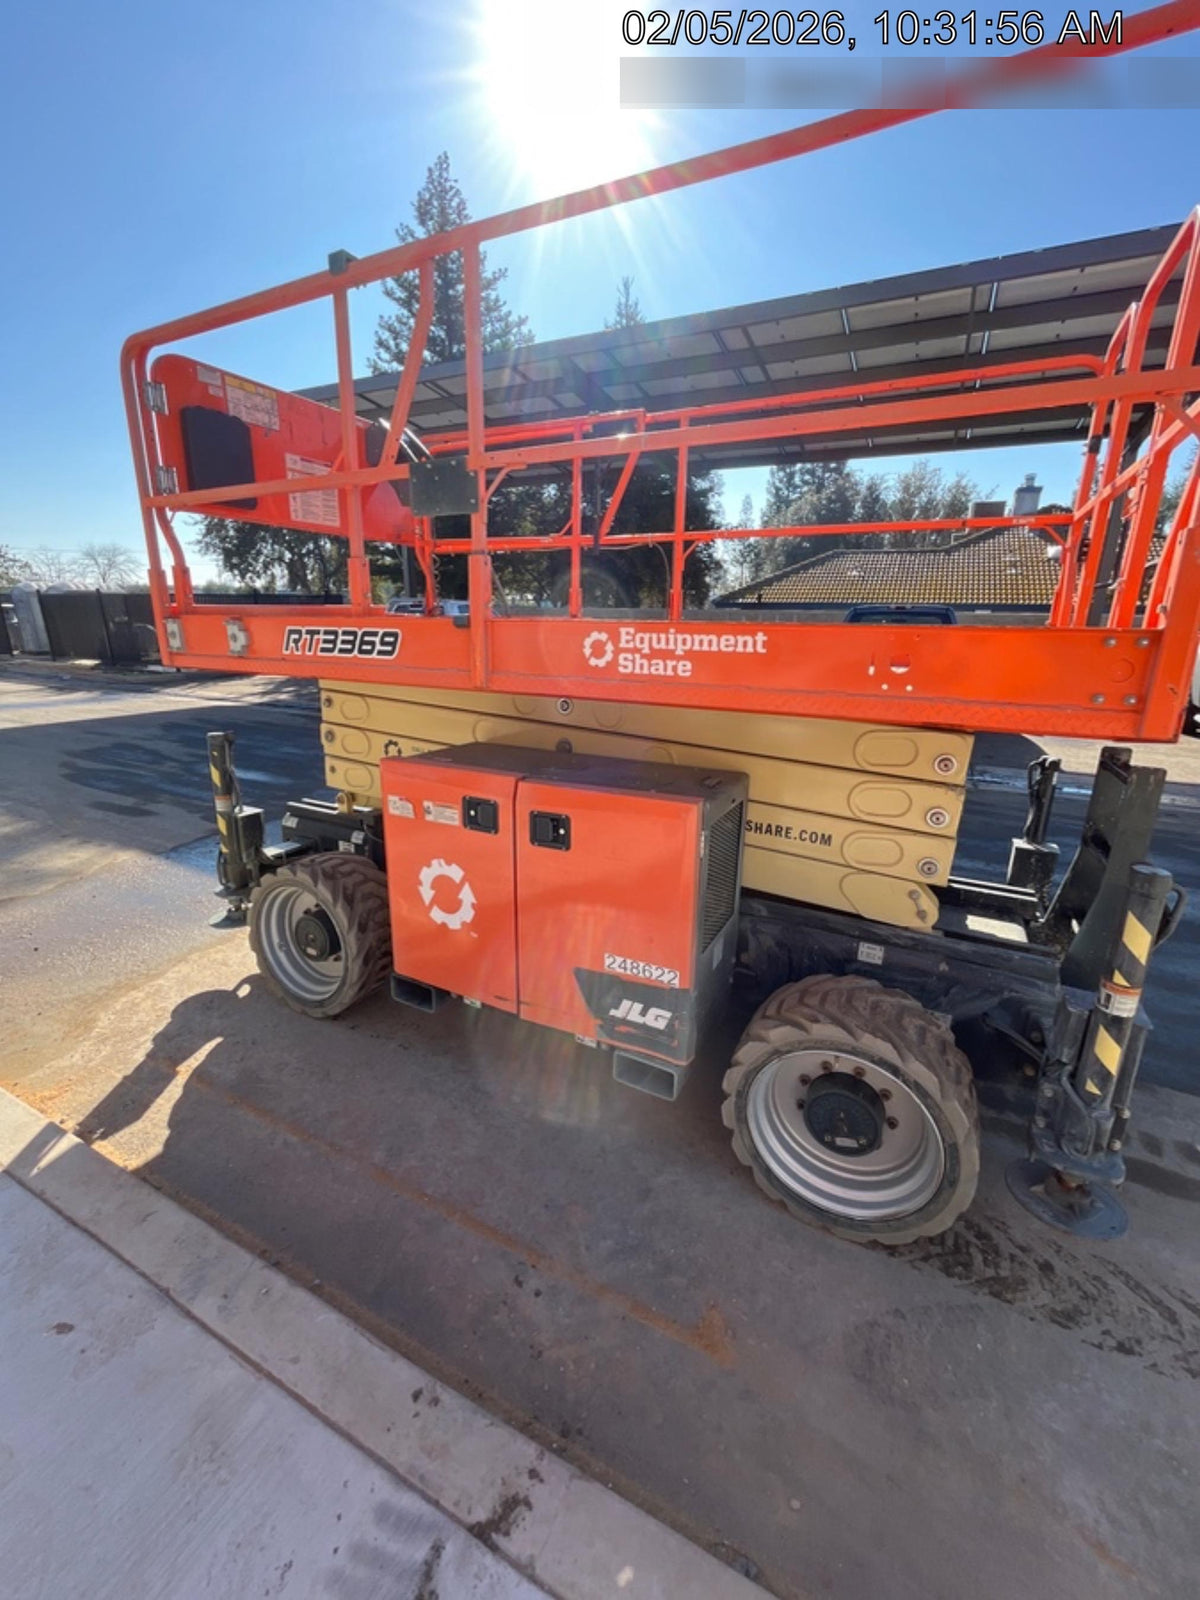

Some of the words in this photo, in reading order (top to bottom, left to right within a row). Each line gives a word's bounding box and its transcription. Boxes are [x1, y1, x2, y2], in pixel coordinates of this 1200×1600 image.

[283, 627, 401, 658] RT3369
[618, 627, 768, 655] Equipment
[618, 652, 693, 677] Share
[605, 953, 679, 986] 248622
[608, 999, 673, 1031] JLG
